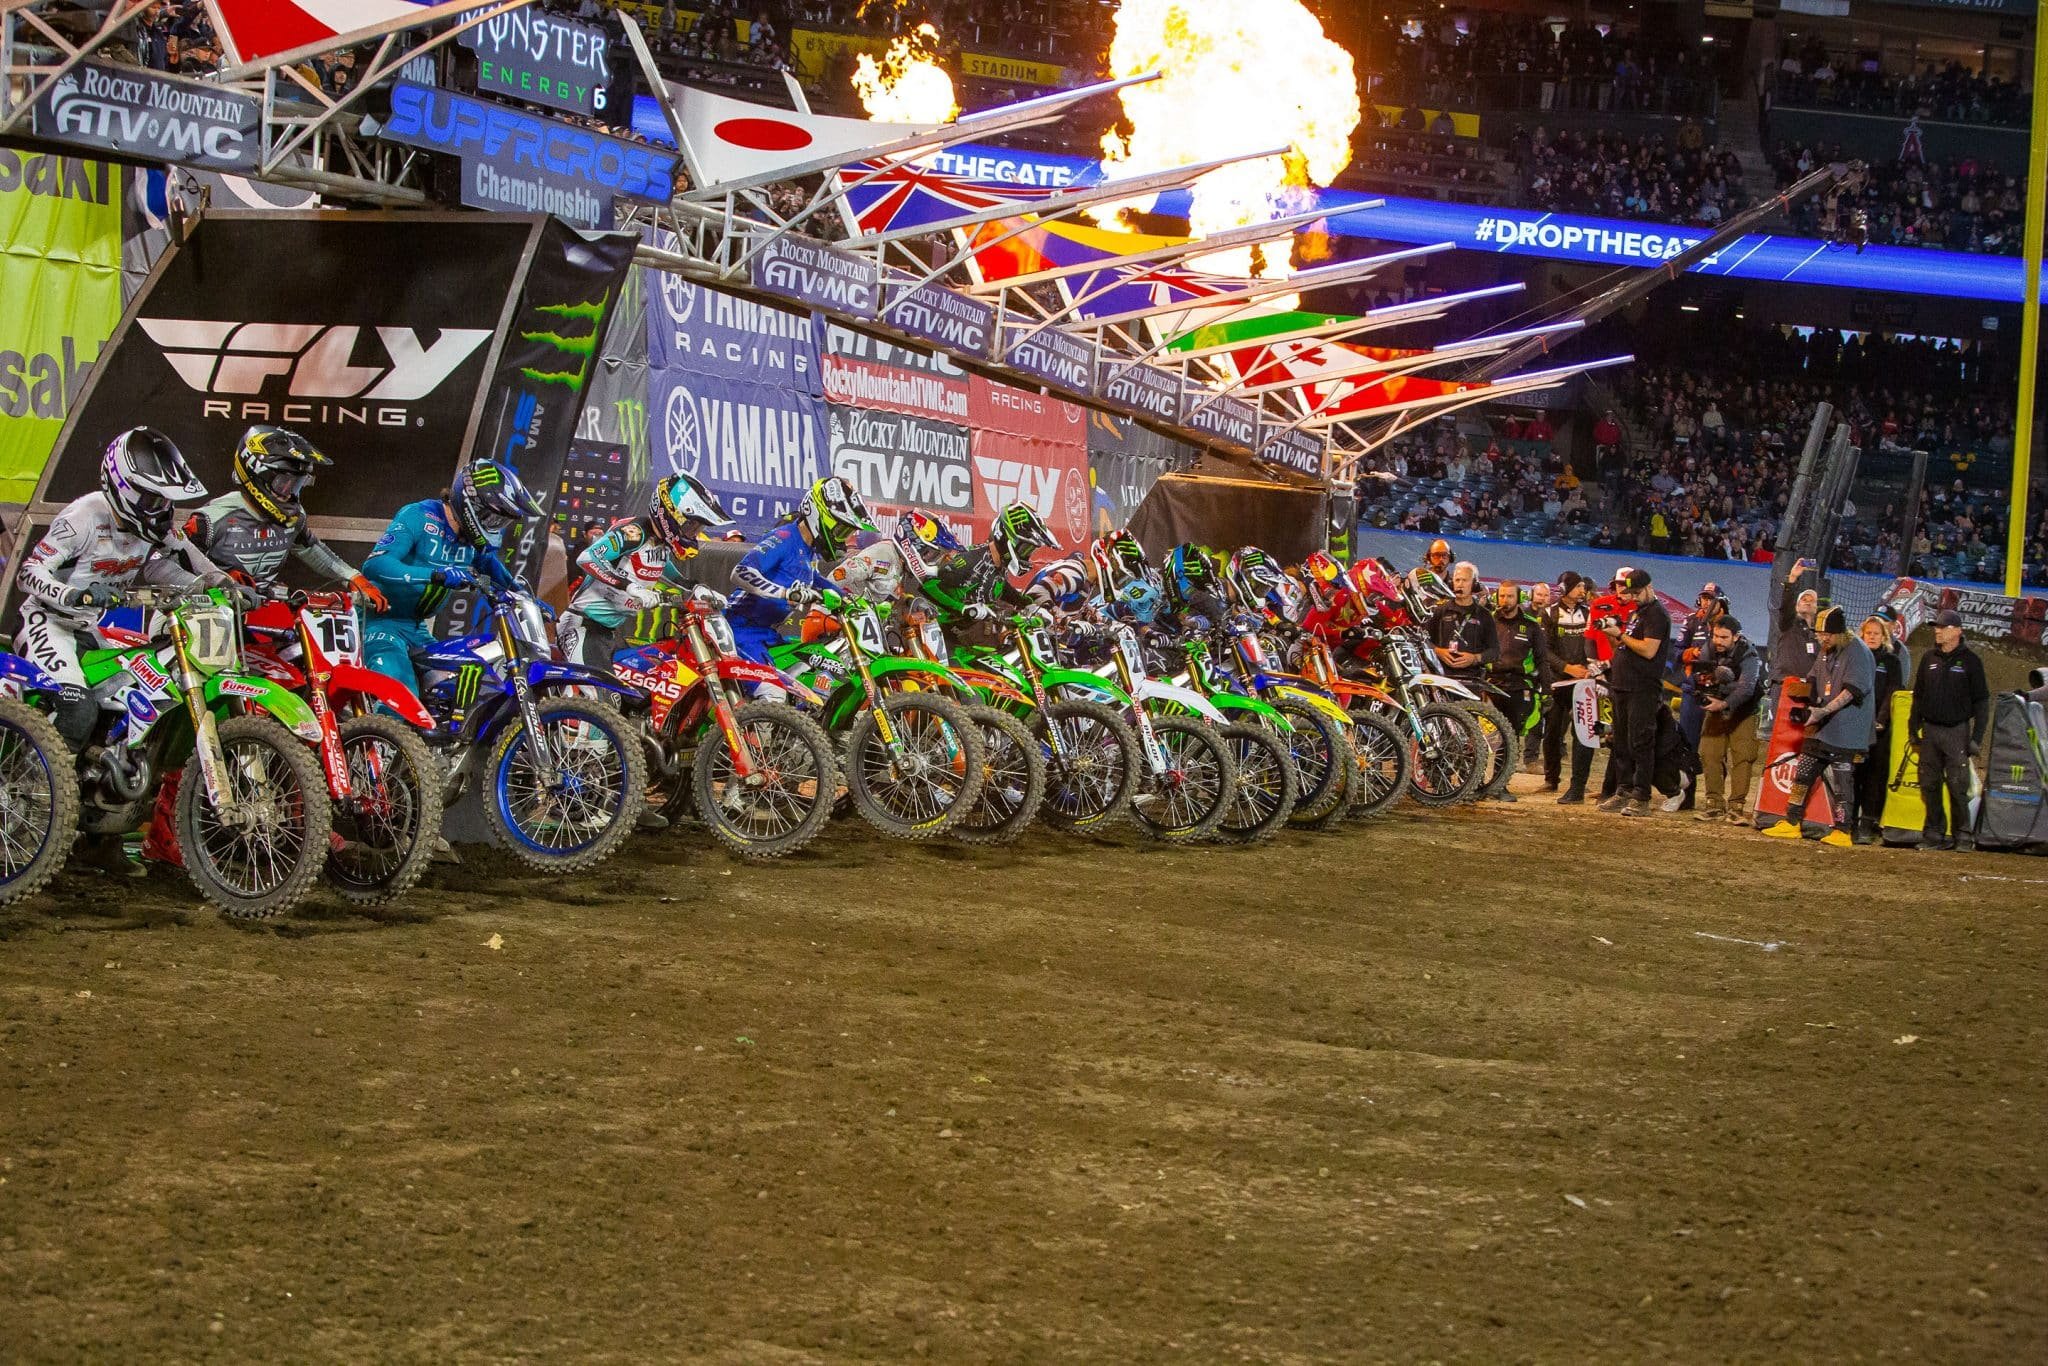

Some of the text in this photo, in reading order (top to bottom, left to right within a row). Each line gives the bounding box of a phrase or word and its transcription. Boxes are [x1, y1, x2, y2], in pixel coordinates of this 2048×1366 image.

[400, 60, 436, 86] AMA
[482, 61, 586, 103] ENERGY
[970, 59, 1038, 81] STADIUM
[83, 67, 244, 125] ROCKY MOUNTAIN
[593, 86, 607, 110] 6
[390, 83, 677, 201] SUPERCROSS
[476, 163, 600, 230] Championship
[780, 239, 869, 283] ROCKY MOUNTAIN
[940, 292, 985, 325] MOUNTAIN
[136, 318, 494, 401] FLY
[675, 331, 808, 373] RACING
[1053, 333, 1089, 364] MOUNTAIN
[203, 399, 408, 426] RACING
[991, 391, 1042, 414] RACING
[700, 396, 819, 491] YAMAHA
[847, 411, 969, 461] ROCKY MOUNTAIN
[974, 456, 1061, 519] FLY
[18, 568, 61, 600] CANVAS
[588, 562, 621, 585] GASGAS
[197, 618, 232, 659] 17
[317, 618, 358, 654] 15
[862, 616, 880, 645] 4
[129, 653, 166, 689] SUMMIT
[220, 679, 269, 696] SUMMIT
[612, 664, 682, 699] GASGAS
[528, 701, 546, 751] DUNLOP
[1575, 701, 1586, 726] HRC
[1585, 697, 1595, 741] HONDA
[1143, 724, 1160, 763] DUNLOP
